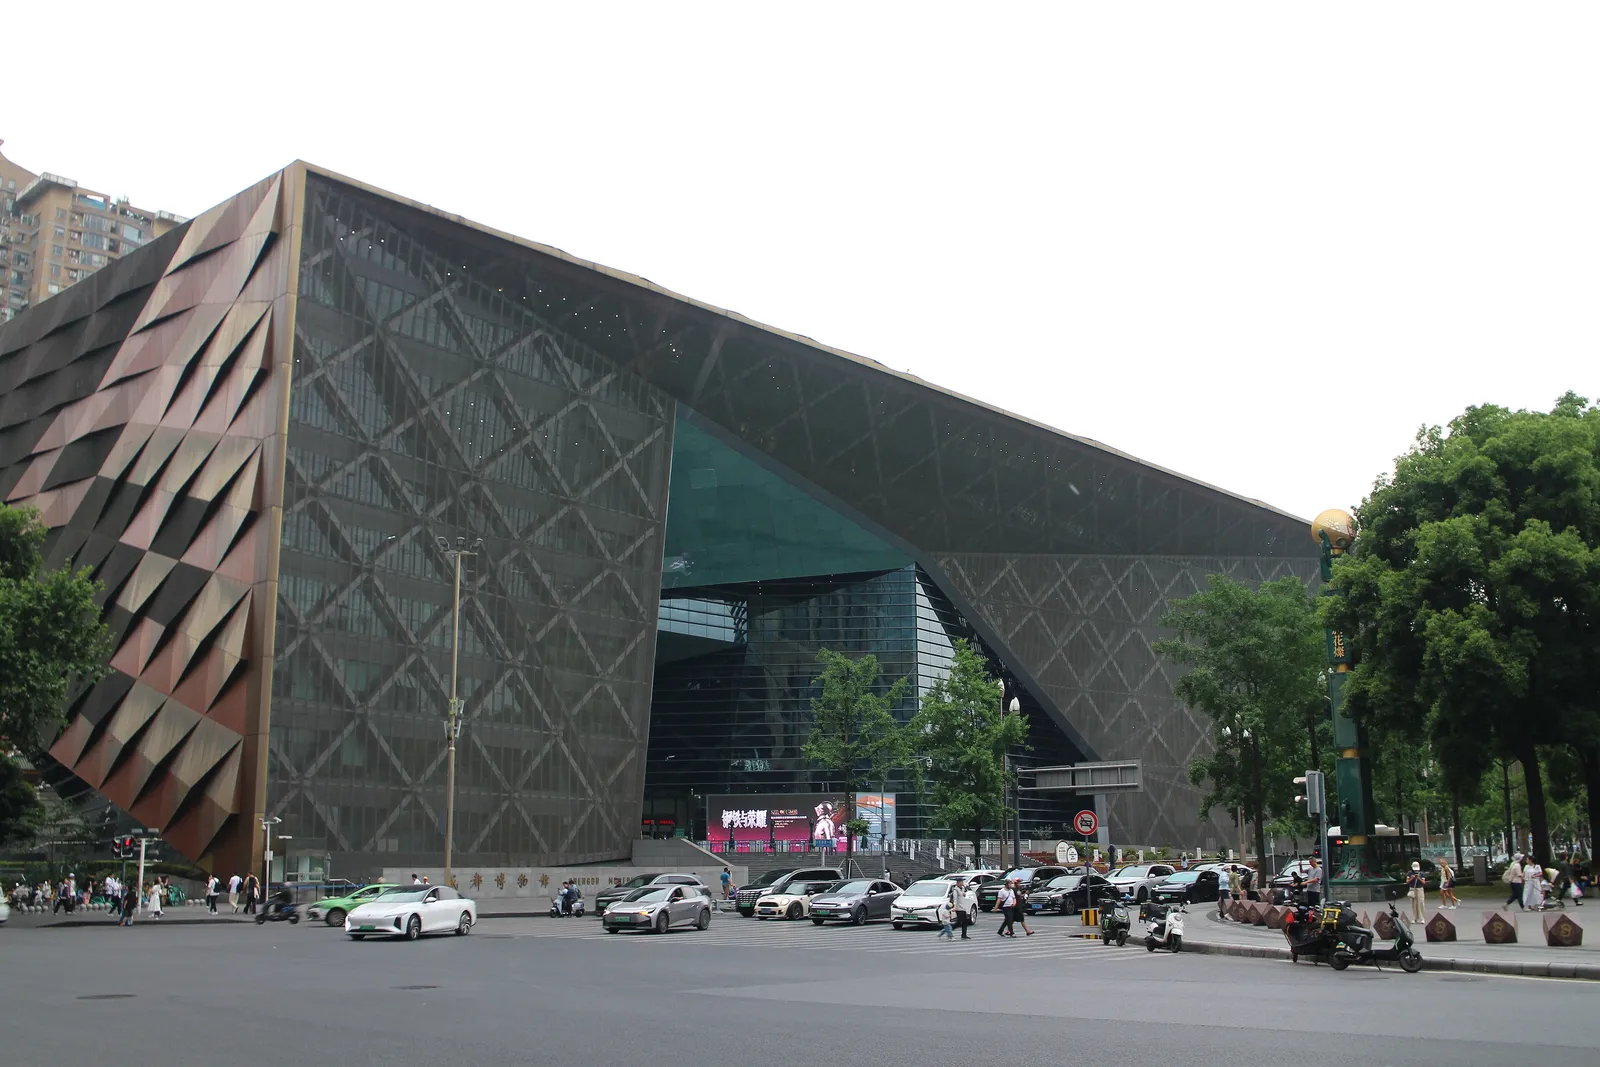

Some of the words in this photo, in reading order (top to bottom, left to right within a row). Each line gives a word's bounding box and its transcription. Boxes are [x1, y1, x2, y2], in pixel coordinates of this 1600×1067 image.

[721, 809, 768, 829] 钢铁与荣耀
